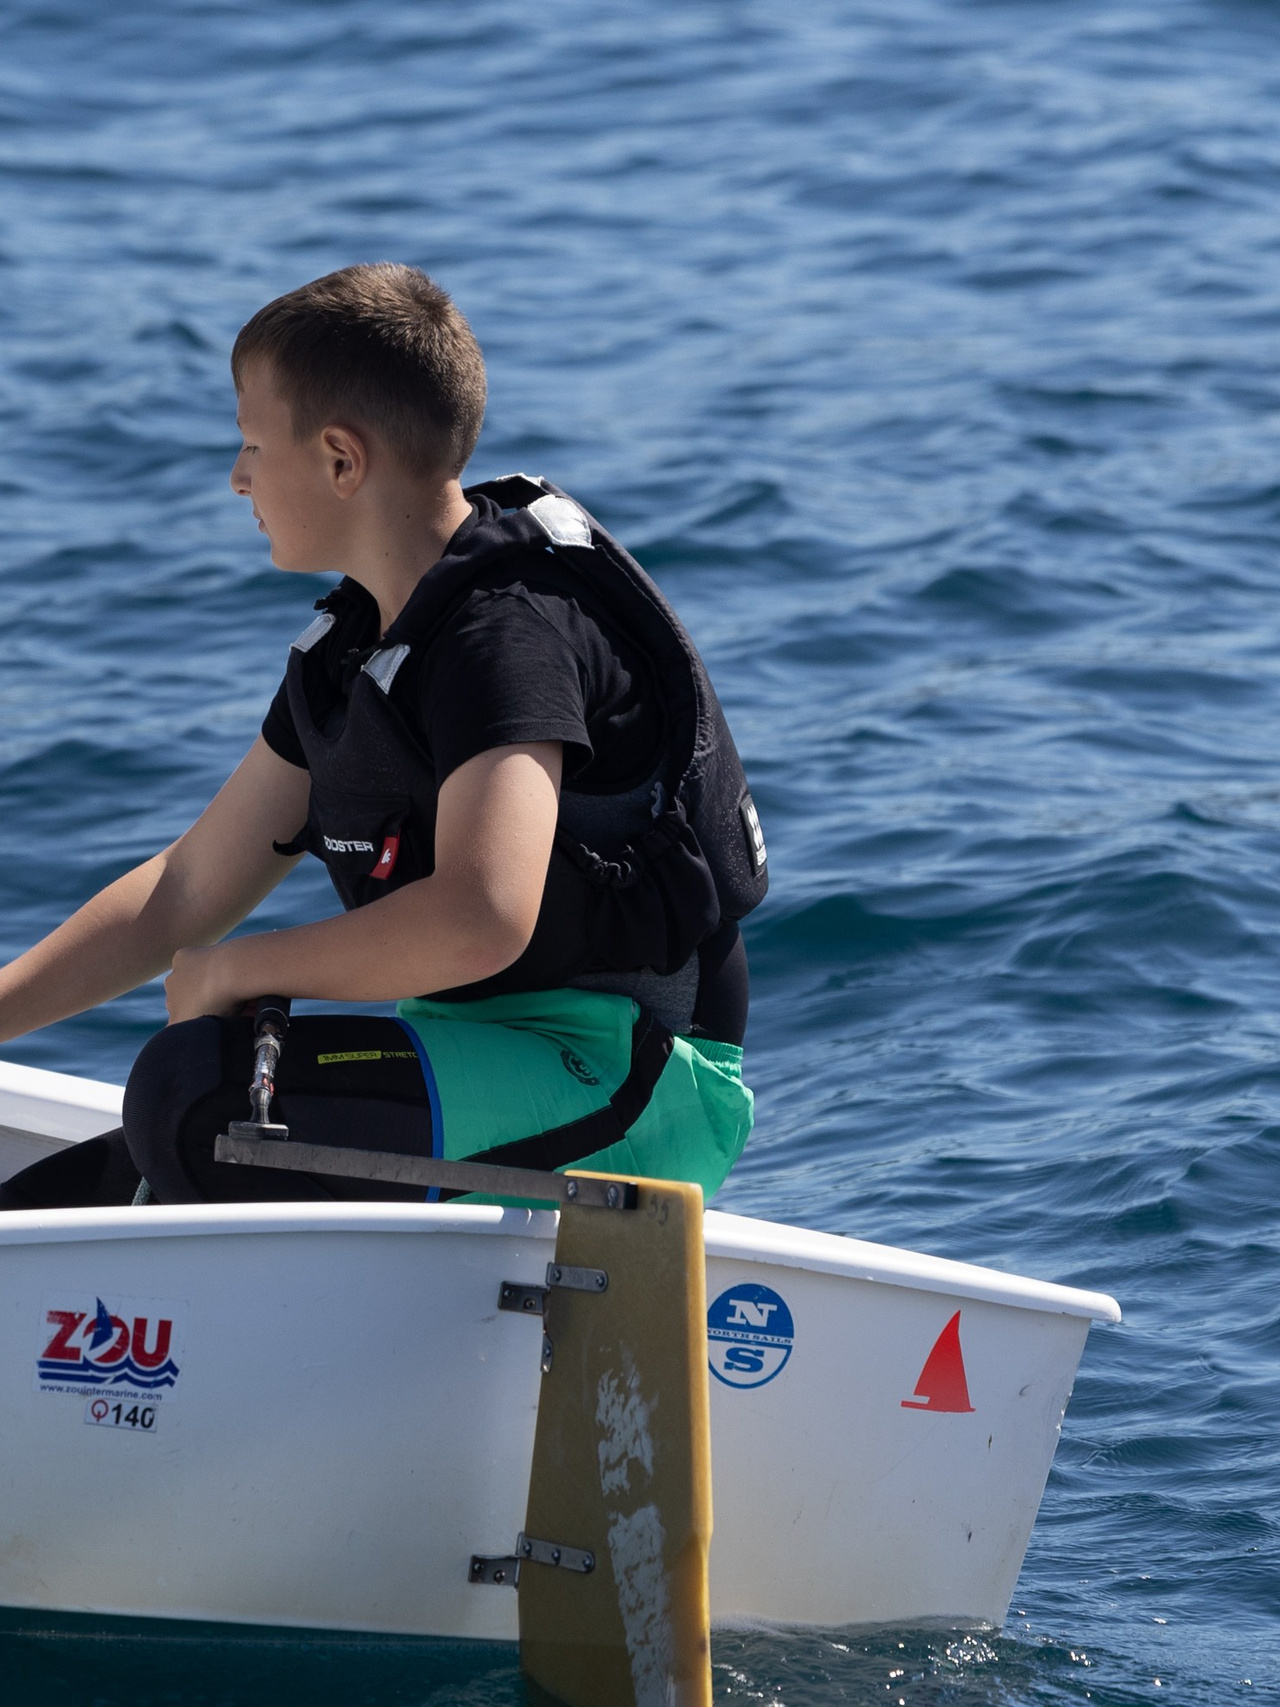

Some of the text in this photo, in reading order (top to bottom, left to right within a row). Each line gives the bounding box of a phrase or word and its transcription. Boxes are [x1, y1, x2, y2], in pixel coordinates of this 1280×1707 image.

[323, 835, 374, 852] OOSTER
[345, 1051, 377, 1059] SUPER
[382, 1051, 419, 1059] STRETC
[726, 1299, 778, 1328] N
[41, 1310, 173, 1369] ZOU
[752, 1334, 792, 1344] SAILS
[724, 1347, 765, 1373] S
[112, 1403, 156, 1430] 140
